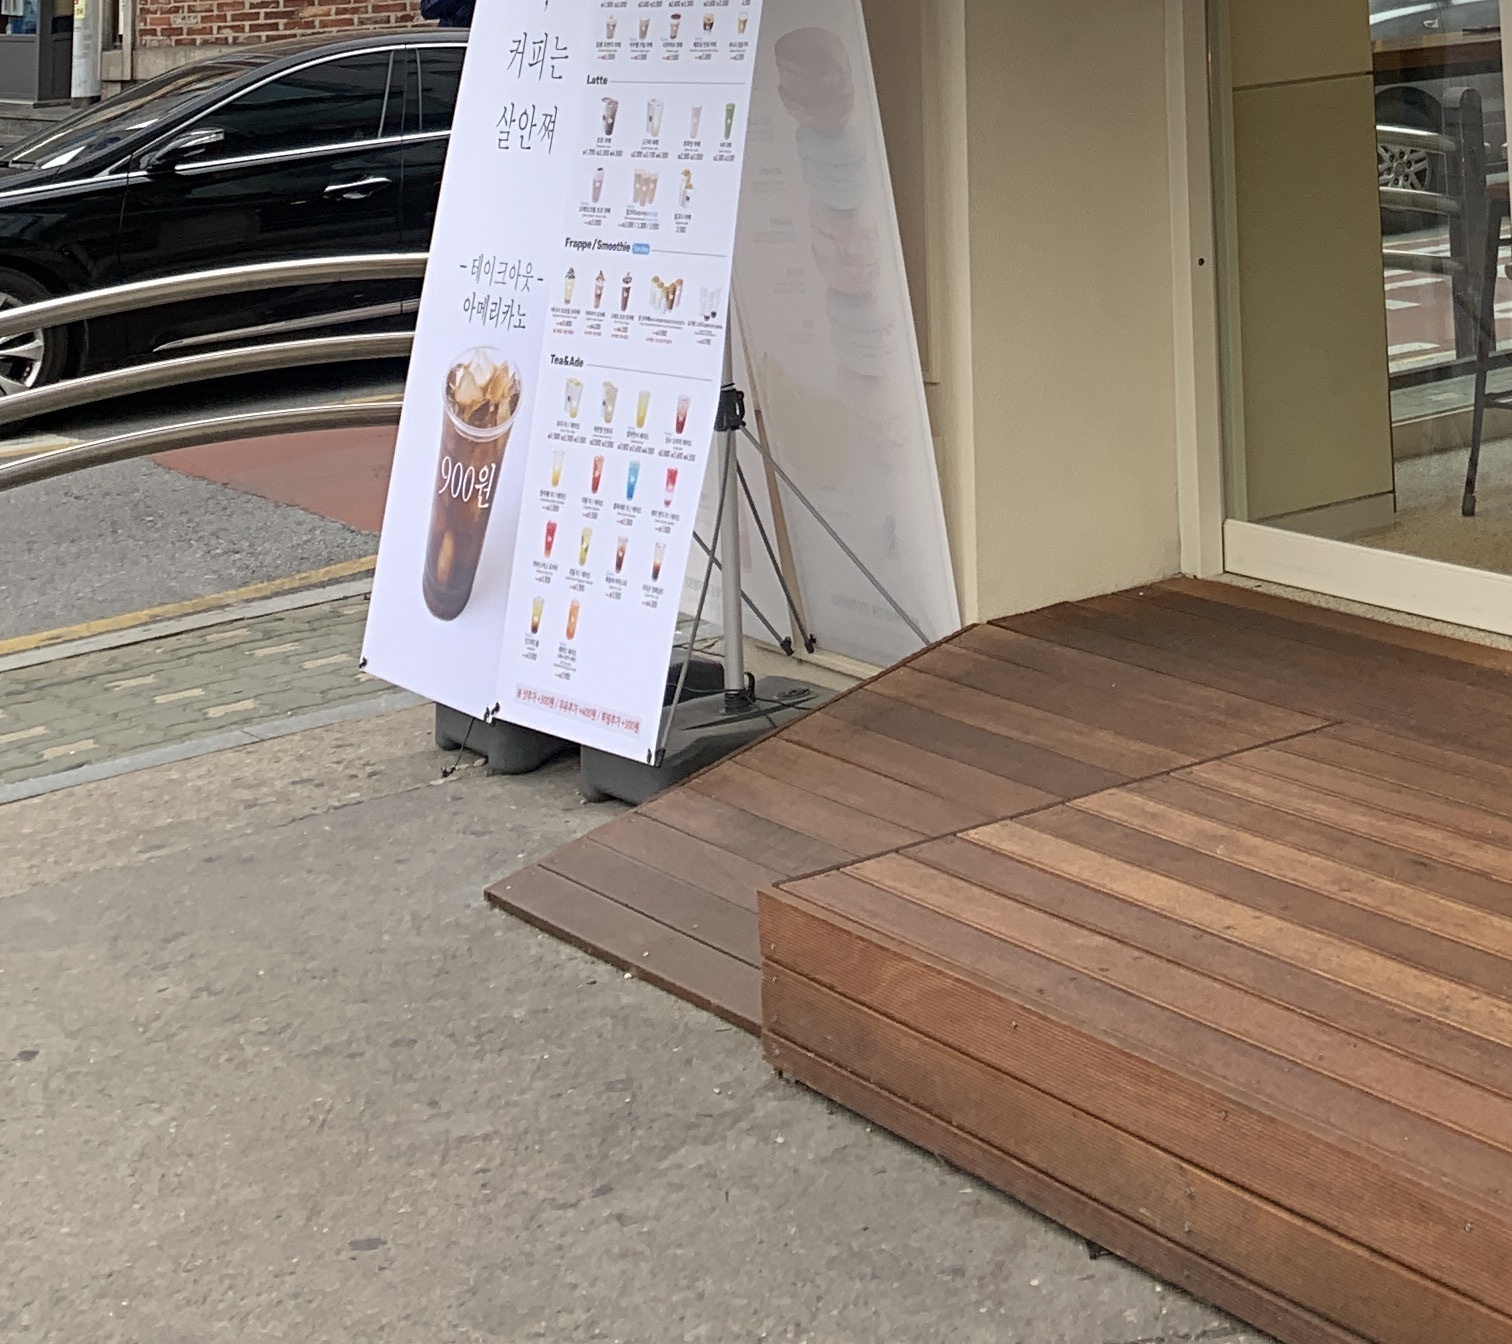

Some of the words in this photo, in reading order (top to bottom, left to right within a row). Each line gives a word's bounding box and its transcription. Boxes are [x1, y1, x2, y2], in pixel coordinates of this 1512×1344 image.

[506, 31, 569, 81] 커피는
[586, 74, 608, 86] Latte
[495, 101, 558, 155] 살안쪄
[463, 291, 527, 331] 아메리카노
[550, 354, 584, 368] Tea&Ade
[438, 456, 496, 509] 900원
